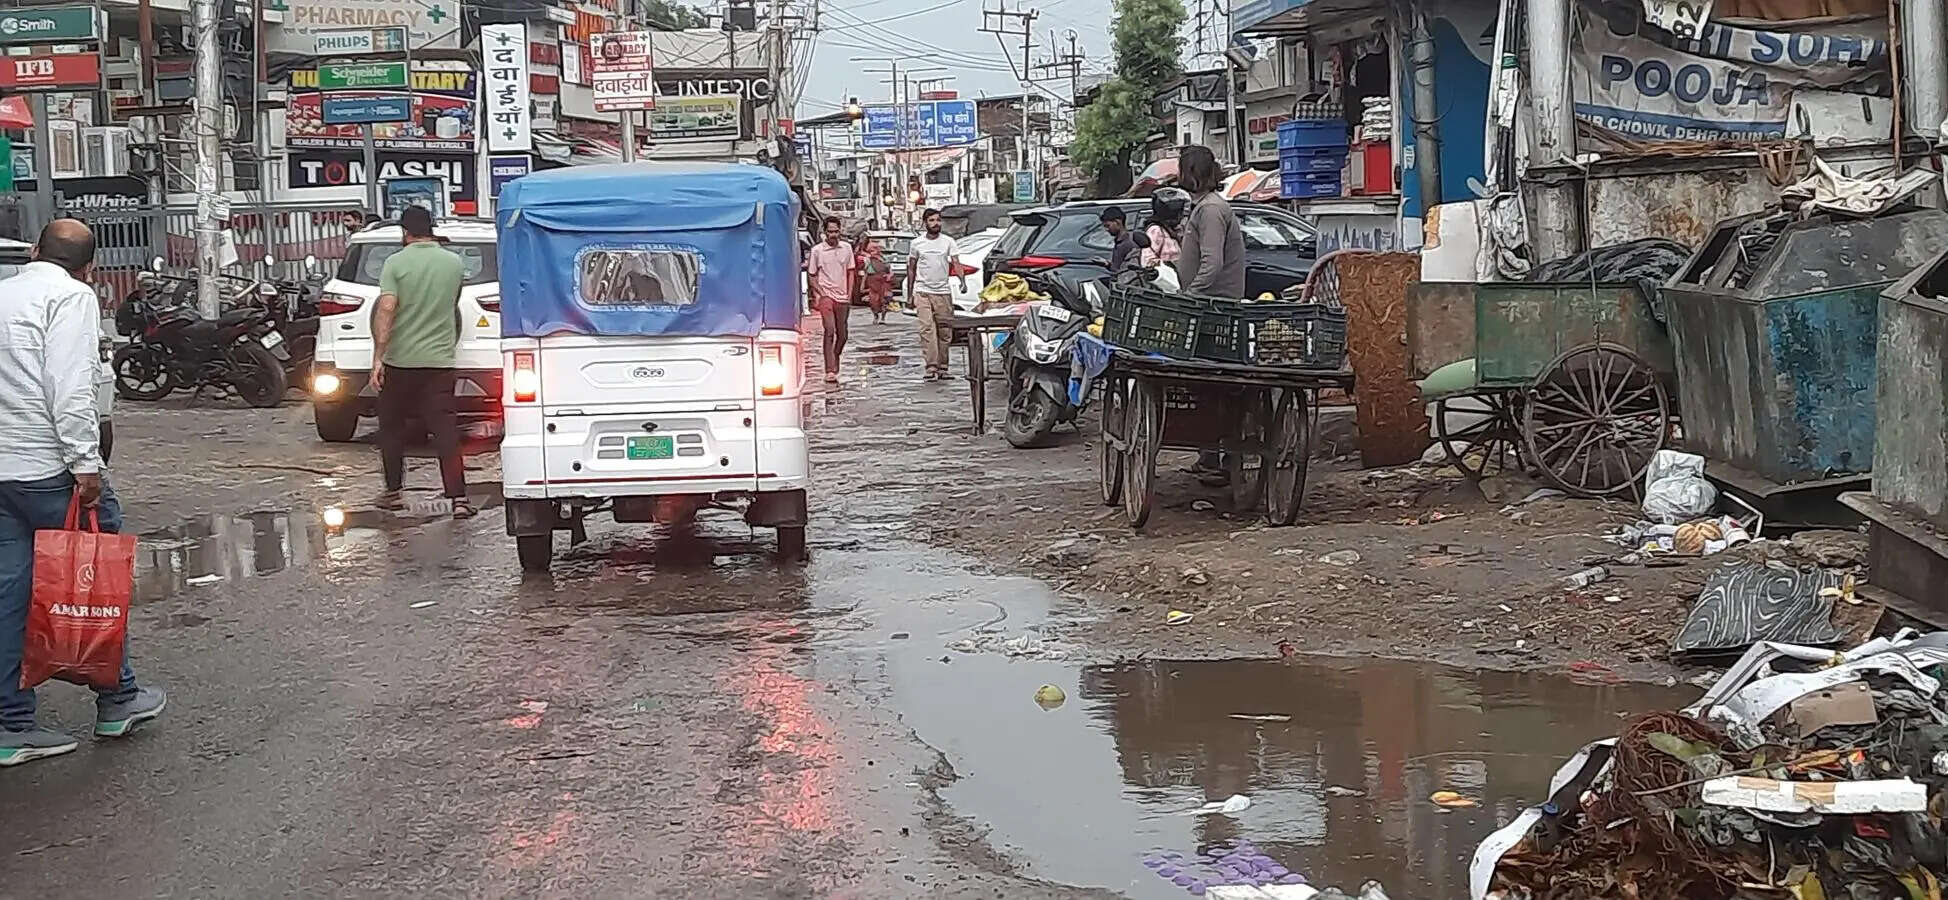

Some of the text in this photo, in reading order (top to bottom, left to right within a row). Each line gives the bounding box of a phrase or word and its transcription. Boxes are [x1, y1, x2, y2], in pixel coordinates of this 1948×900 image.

[18, 18, 56, 31] Smith
[294, 6, 422, 27] PHARMACY
[317, 35, 370, 49] PHILIPS
[15, 59, 54, 76] IFB
[331, 66, 390, 79] Schneider
[1602, 55, 1769, 105] POOJA
[1607, 117, 1671, 138] CHOWK,
[1675, 126, 1762, 141] DEHRADUN
